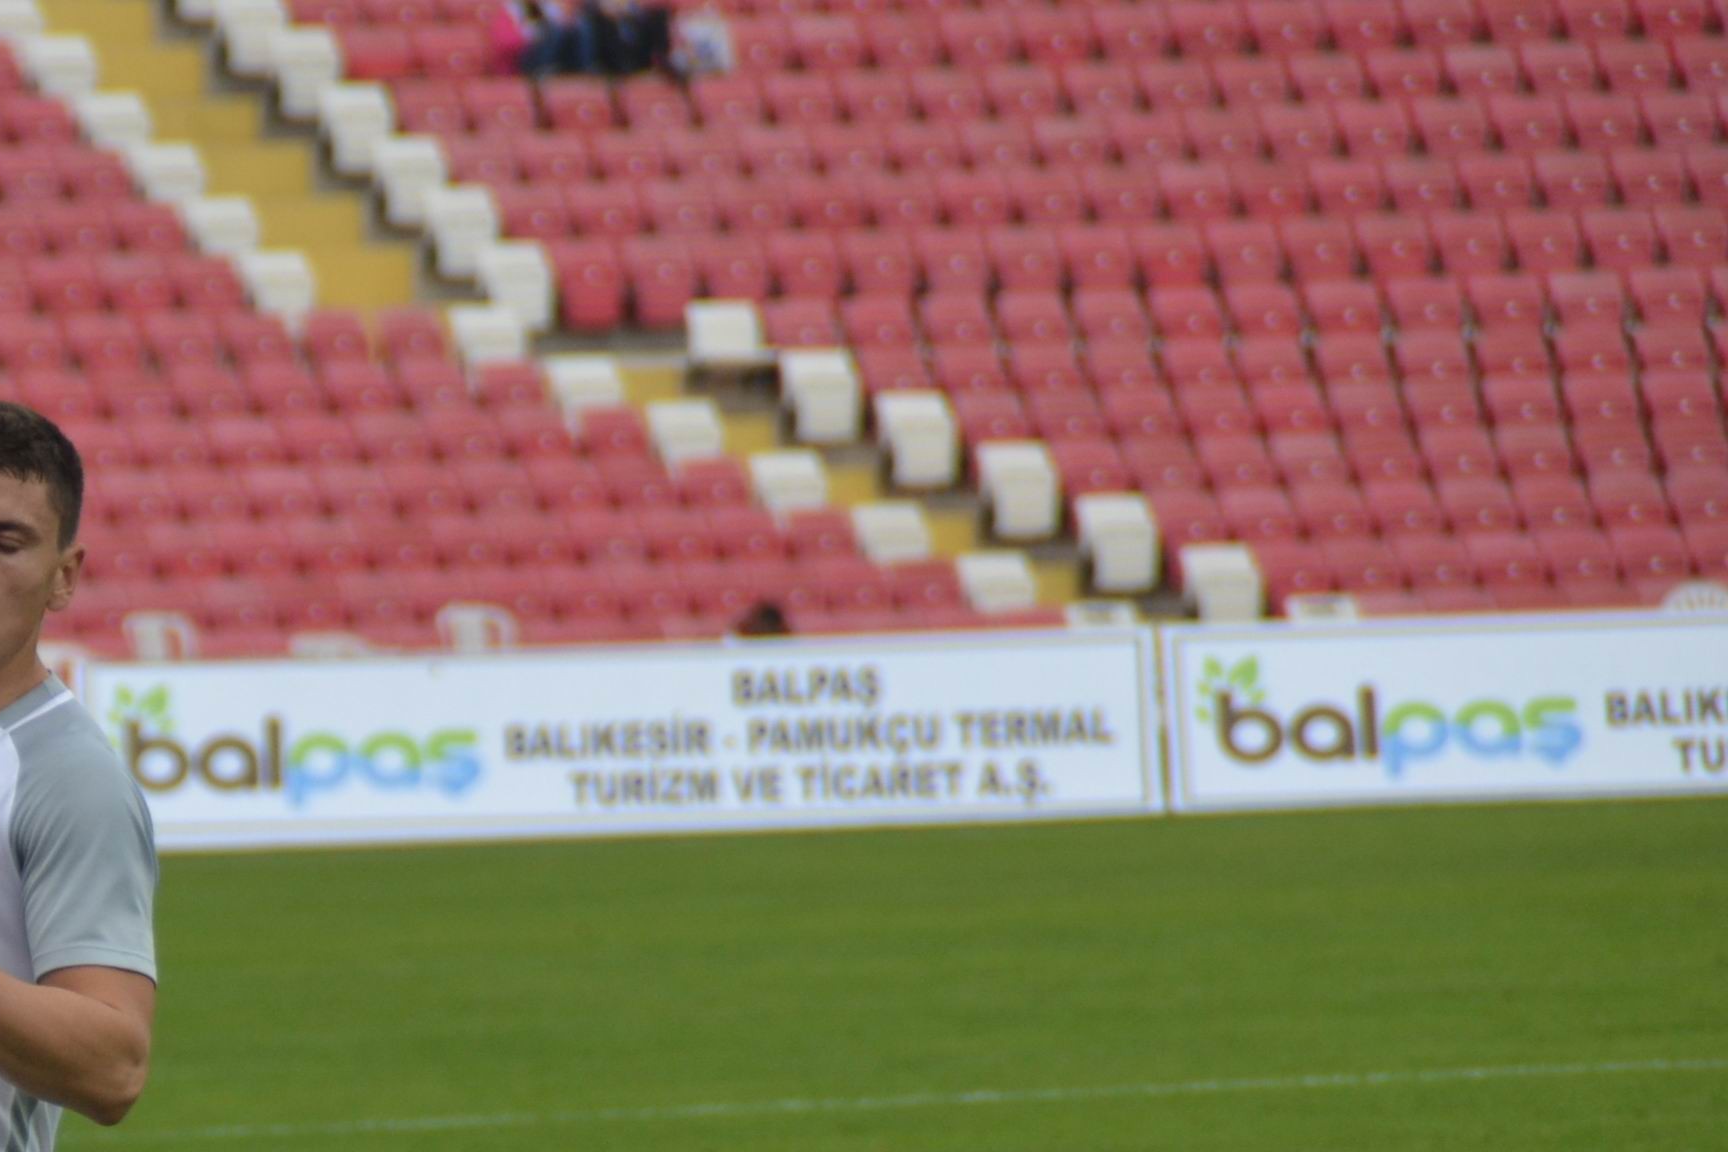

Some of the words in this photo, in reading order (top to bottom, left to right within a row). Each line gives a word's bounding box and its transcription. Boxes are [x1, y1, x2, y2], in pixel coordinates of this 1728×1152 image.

[731, 666, 881, 709] BALPAŞ
[505, 712, 710, 760] BALIKESİR
[747, 714, 941, 756] PAMUKÇU
[954, 707, 1115, 747] TERMAL
[1215, 683, 1582, 779] balpaş
[127, 712, 482, 806] balpaş
[572, 764, 718, 806] TURİZM
[732, 767, 783, 803] VE
[797, 759, 962, 799] TİCARET
[978, 758, 1052, 807] A.Ş.
